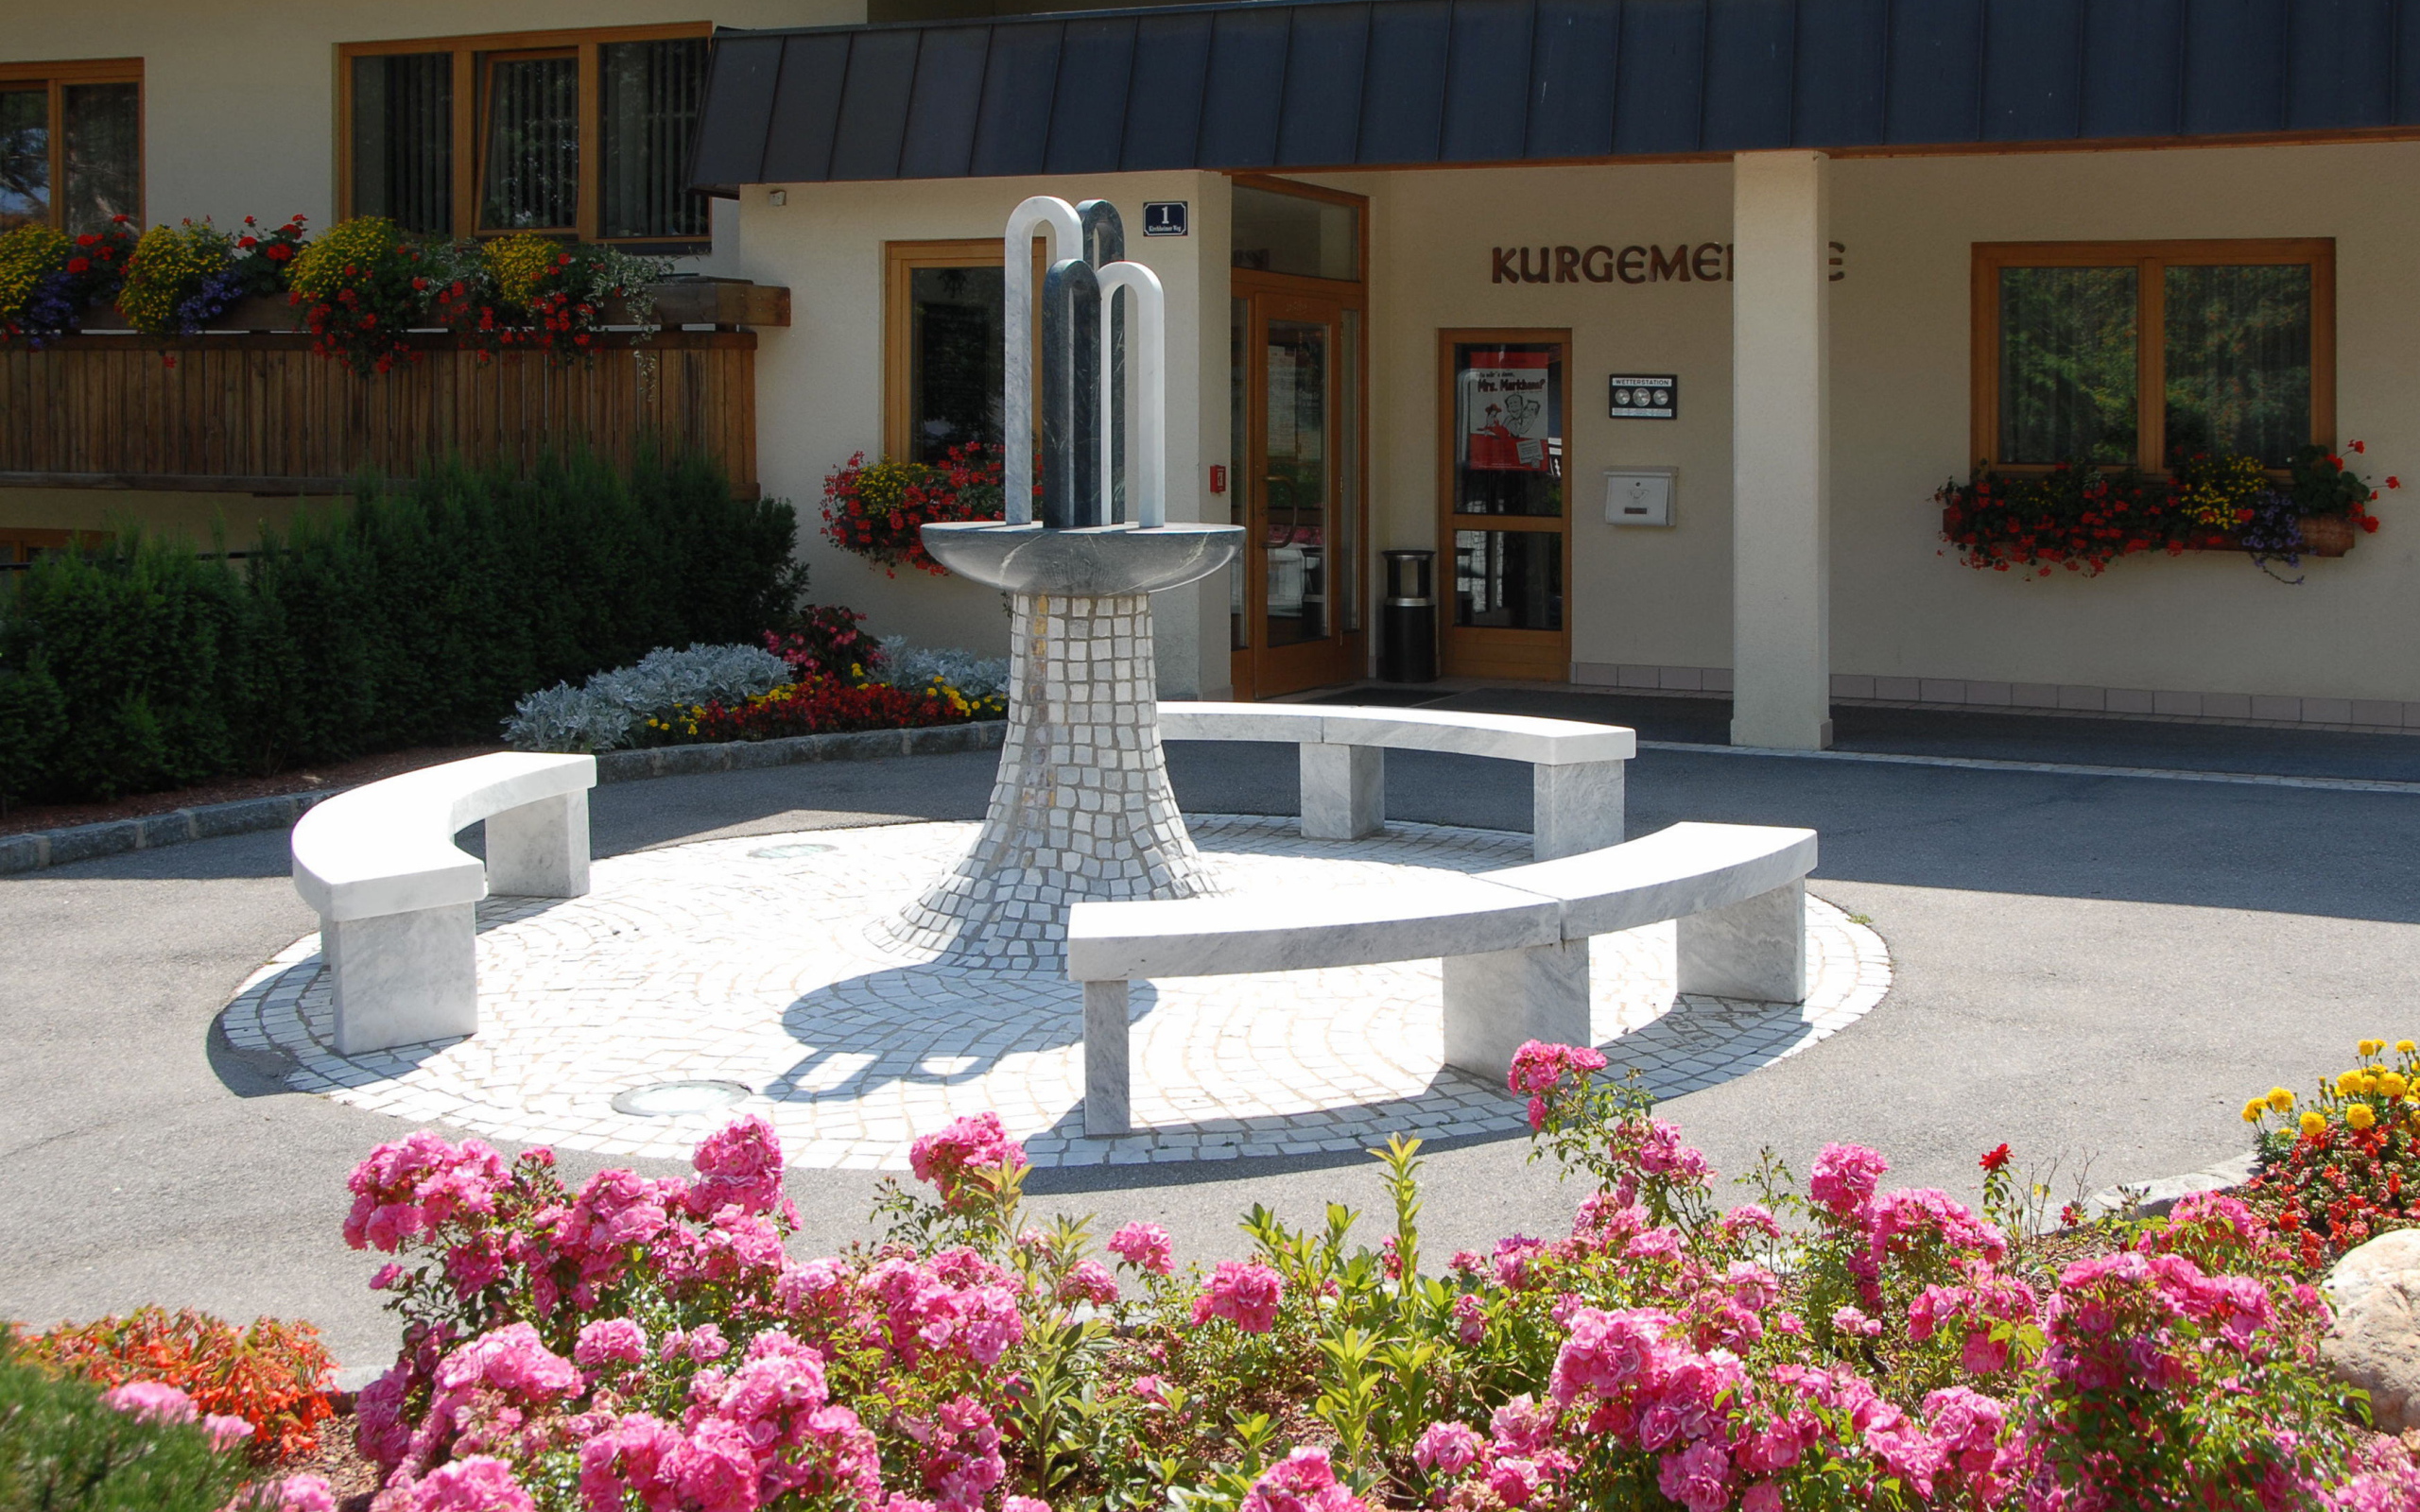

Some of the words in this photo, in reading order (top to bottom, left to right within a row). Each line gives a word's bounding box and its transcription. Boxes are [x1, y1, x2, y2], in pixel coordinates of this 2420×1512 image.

[1162, 205, 1169, 224] 1
[1491, 241, 1846, 284] KURGEMEIE
[1478, 378, 1498, 392] Mrs.
